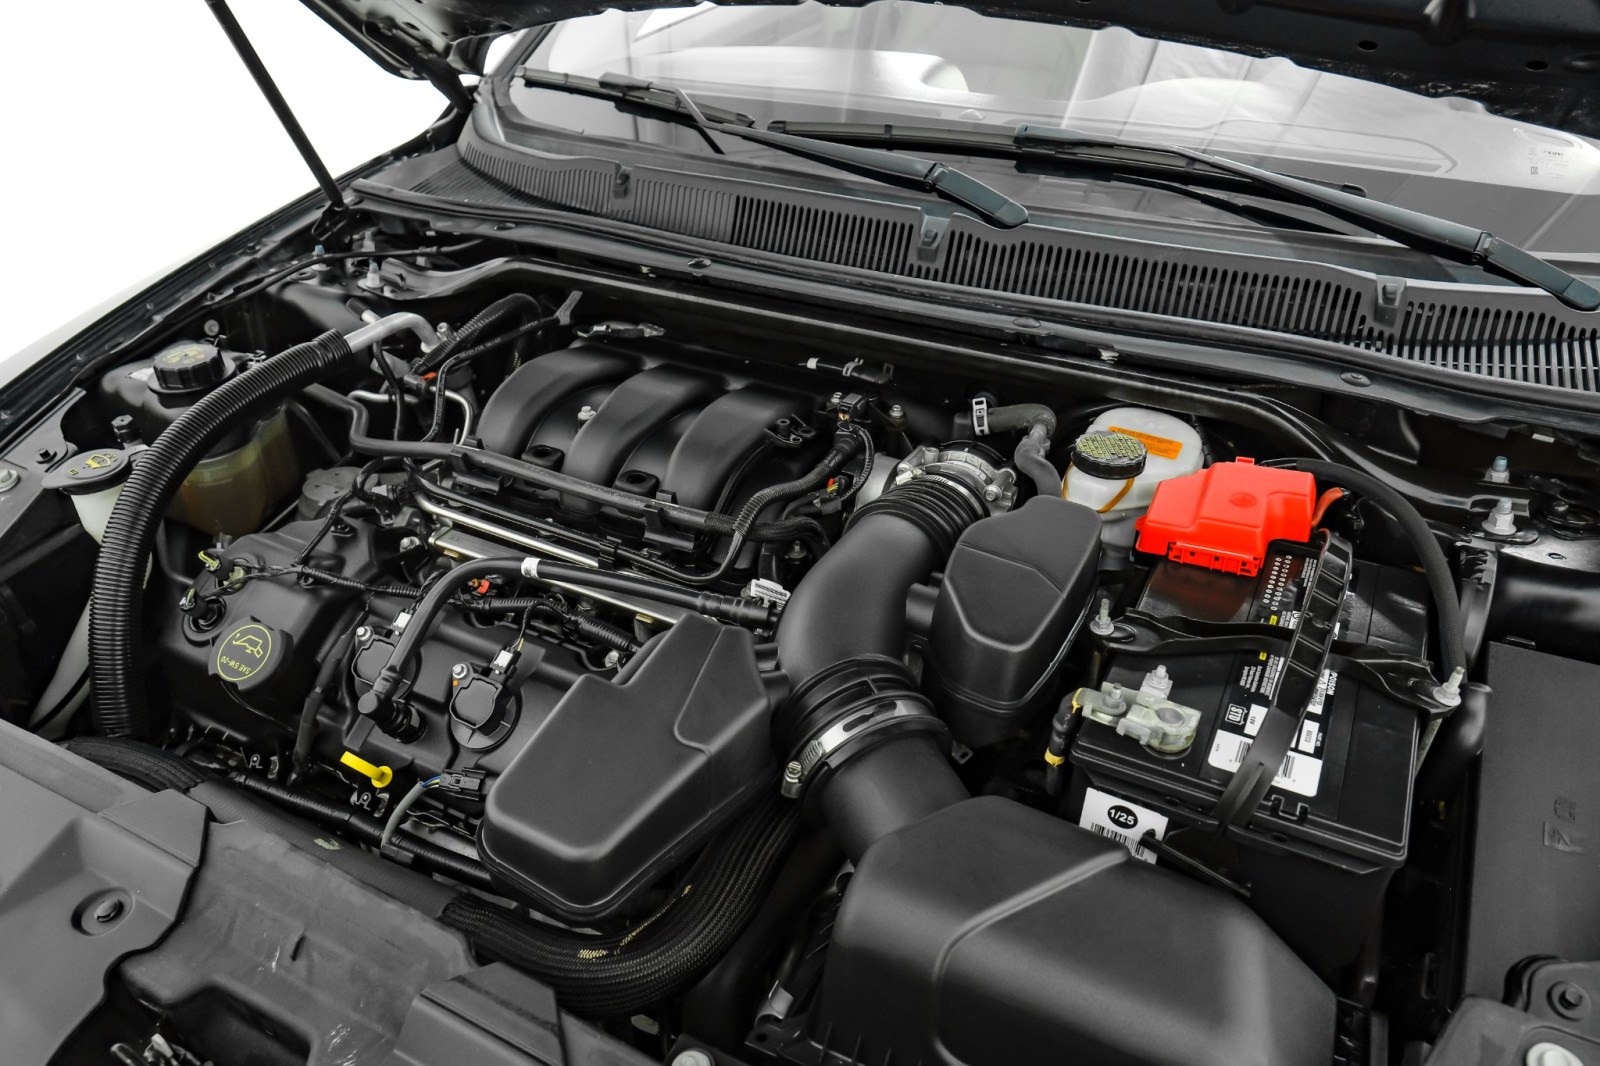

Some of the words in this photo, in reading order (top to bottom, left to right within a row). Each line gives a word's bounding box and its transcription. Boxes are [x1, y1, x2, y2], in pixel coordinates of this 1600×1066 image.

[221, 656, 238, 668] 5W-20
[239, 664, 251, 674] SAE
[1327, 671, 1337, 695] POISON
[1228, 706, 1243, 721] STD
[1109, 809, 1135, 824] 1/25
